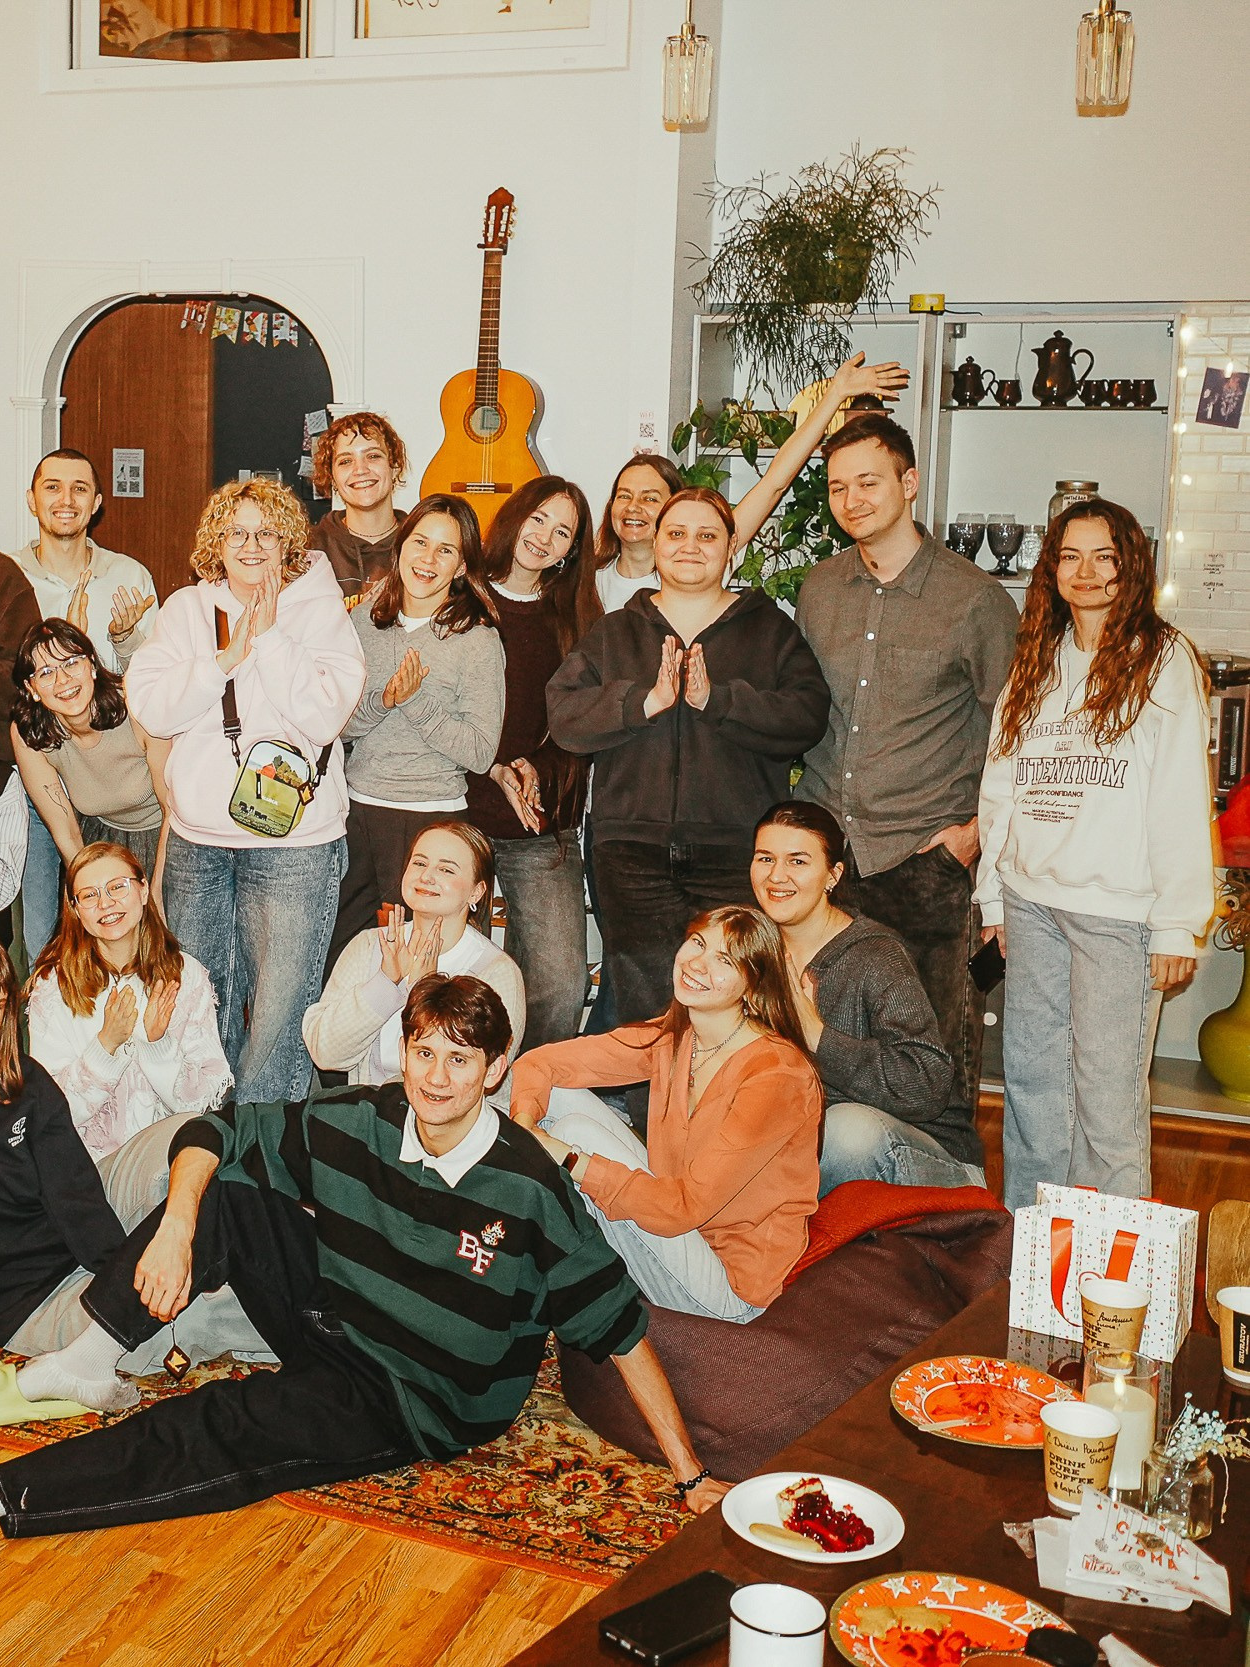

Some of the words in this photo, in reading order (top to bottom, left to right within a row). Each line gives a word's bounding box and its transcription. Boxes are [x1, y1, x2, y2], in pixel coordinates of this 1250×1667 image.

[456, 1230, 496, 1276] BF
[1238, 1322, 1247, 1364] SKURATOV
[1049, 1451, 1086, 1469] DRINK
[1049, 1460, 1080, 1476] PURE
[1049, 1468, 1094, 1485] COFFEE
